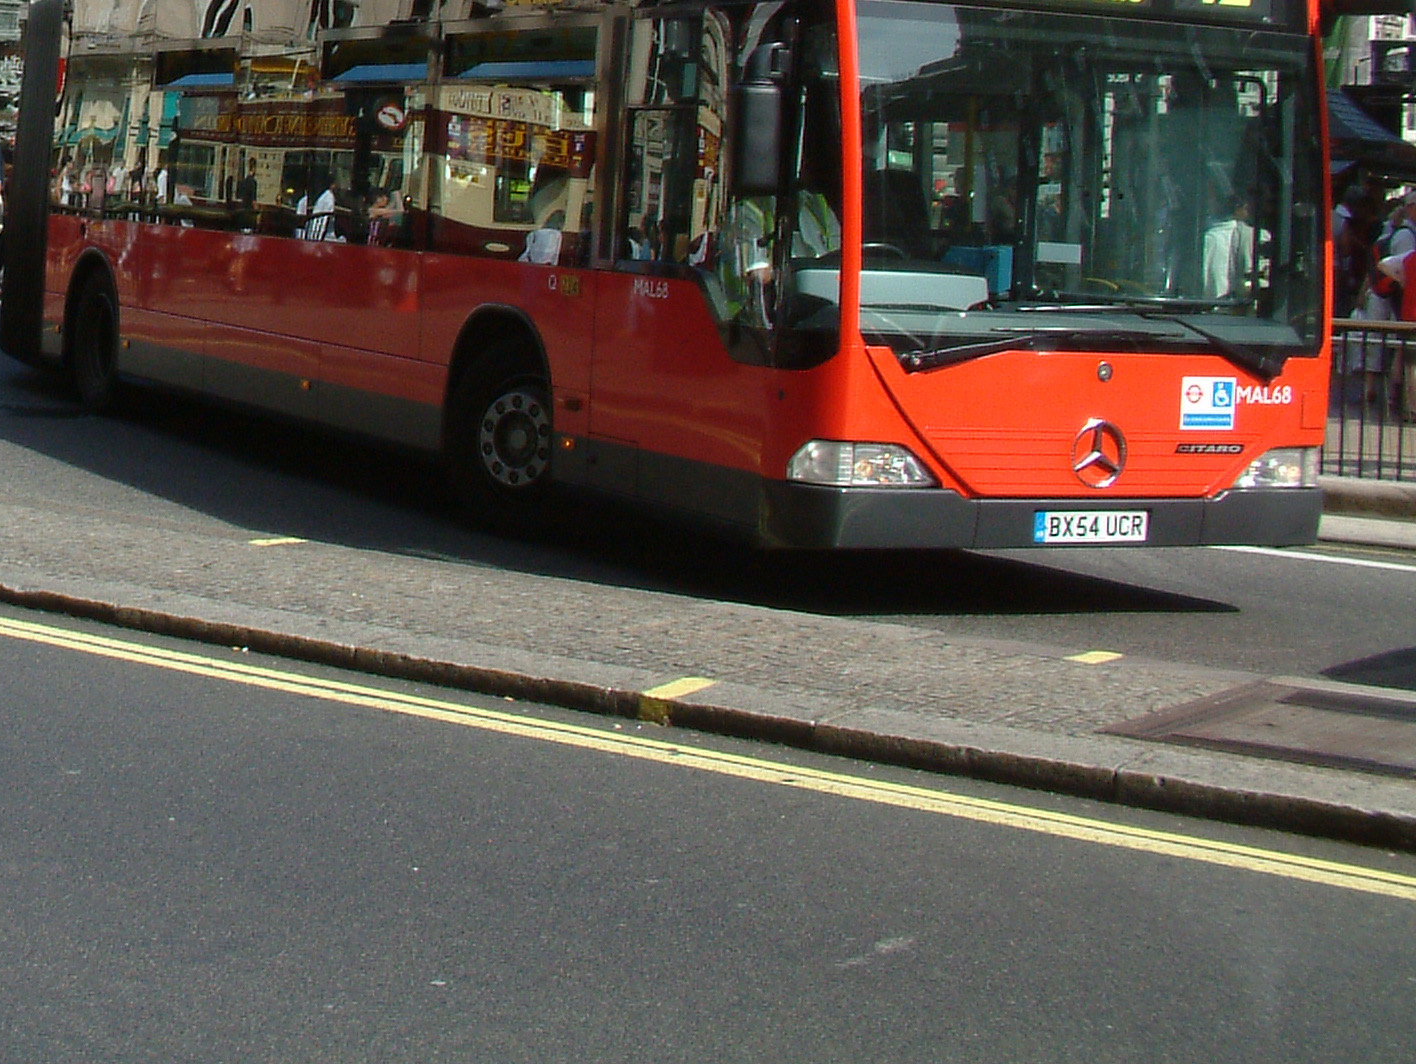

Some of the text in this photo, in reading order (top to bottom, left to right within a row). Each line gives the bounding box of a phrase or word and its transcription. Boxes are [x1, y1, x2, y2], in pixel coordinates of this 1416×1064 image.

[1235, 385, 1292, 405] MAL68
[1177, 444, 1243, 454] CITARO
[1049, 515, 1144, 537] BX54 UCR
